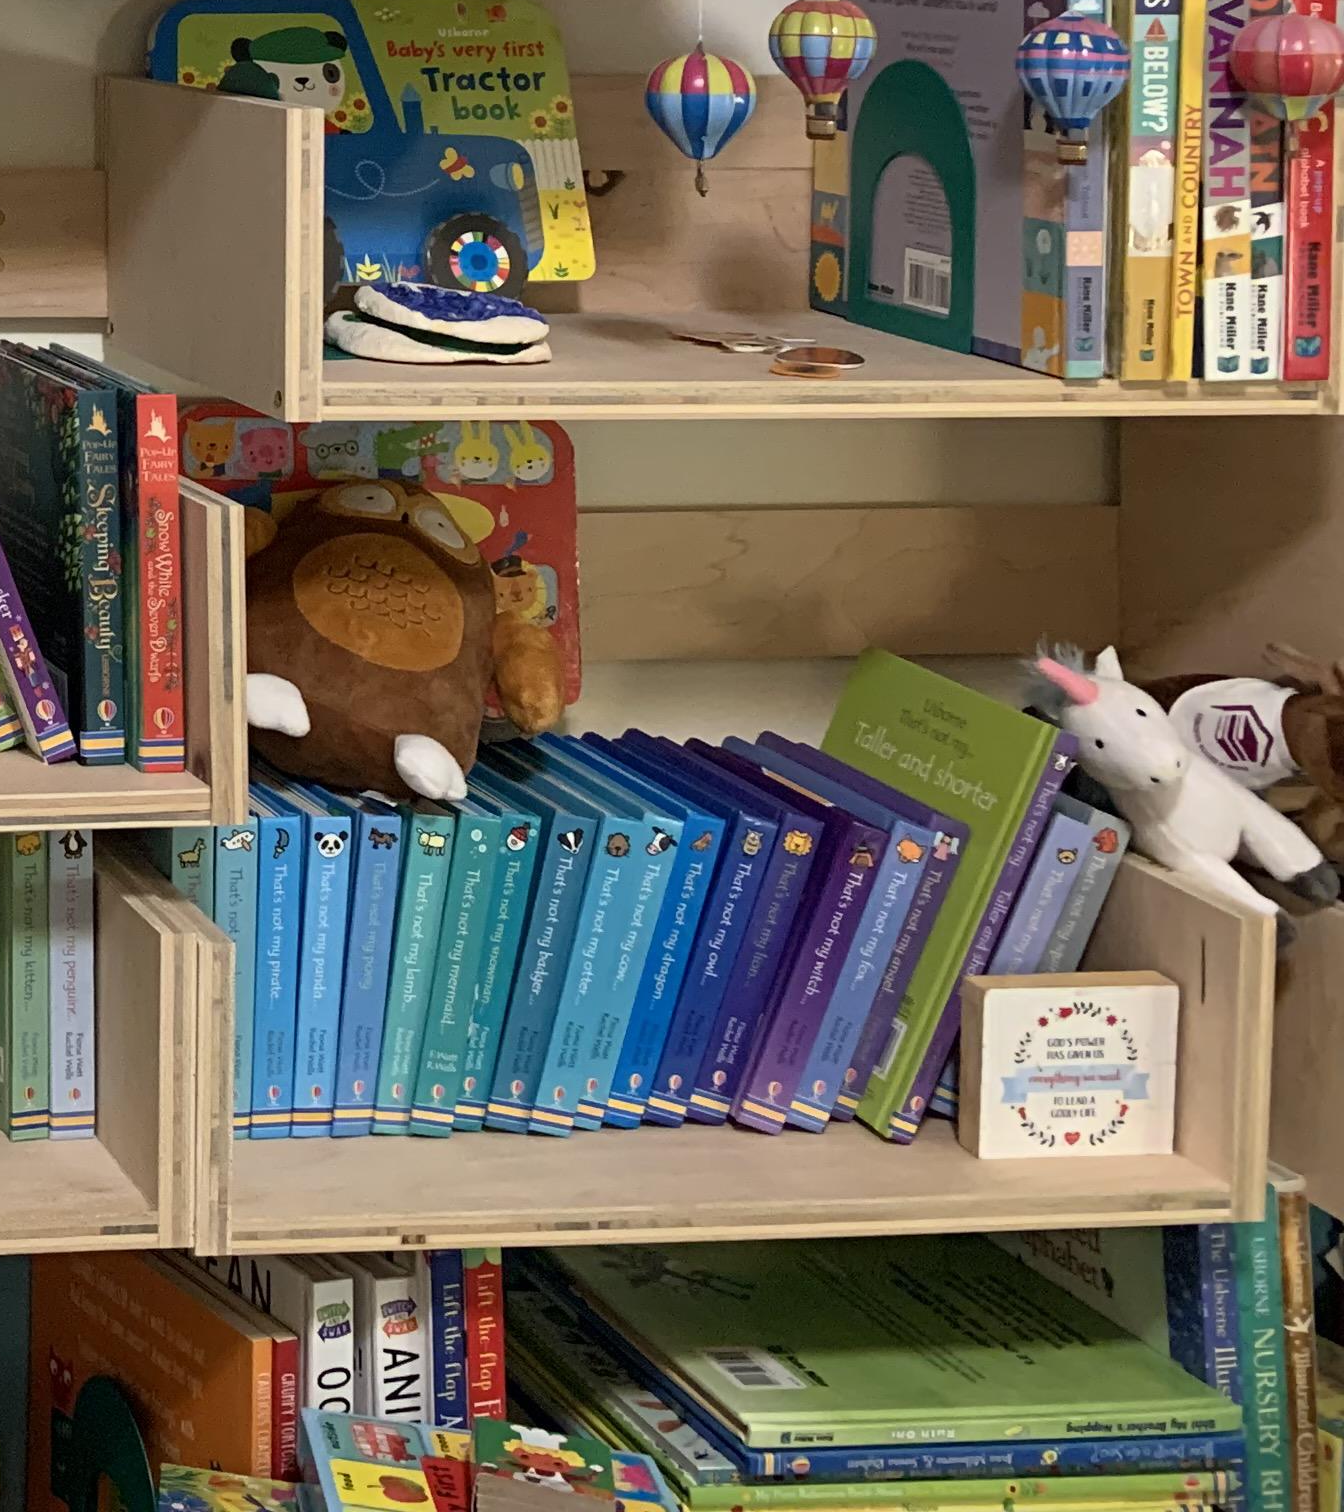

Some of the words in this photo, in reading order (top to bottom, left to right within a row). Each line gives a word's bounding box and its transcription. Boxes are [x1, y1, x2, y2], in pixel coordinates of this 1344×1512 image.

[387, 40, 446, 62] Baby's
[453, 43, 497, 63] very
[503, 40, 546, 58] first
[420, 66, 546, 92] Tractor
[451, 96, 522, 121] book
[1146, 47, 1170, 132] BELOW?
[854, 721, 899, 760] Taller
[899, 751, 936, 782] and
[934, 761, 998, 811] shorter
[1047, 1038, 1073, 1047] GOD'S
[1075, 1038, 1104, 1046] POWER
[437, 1283, 461, 1400] Lift-the-flap
[1253, 1327, 1282, 1458] NURSERY
